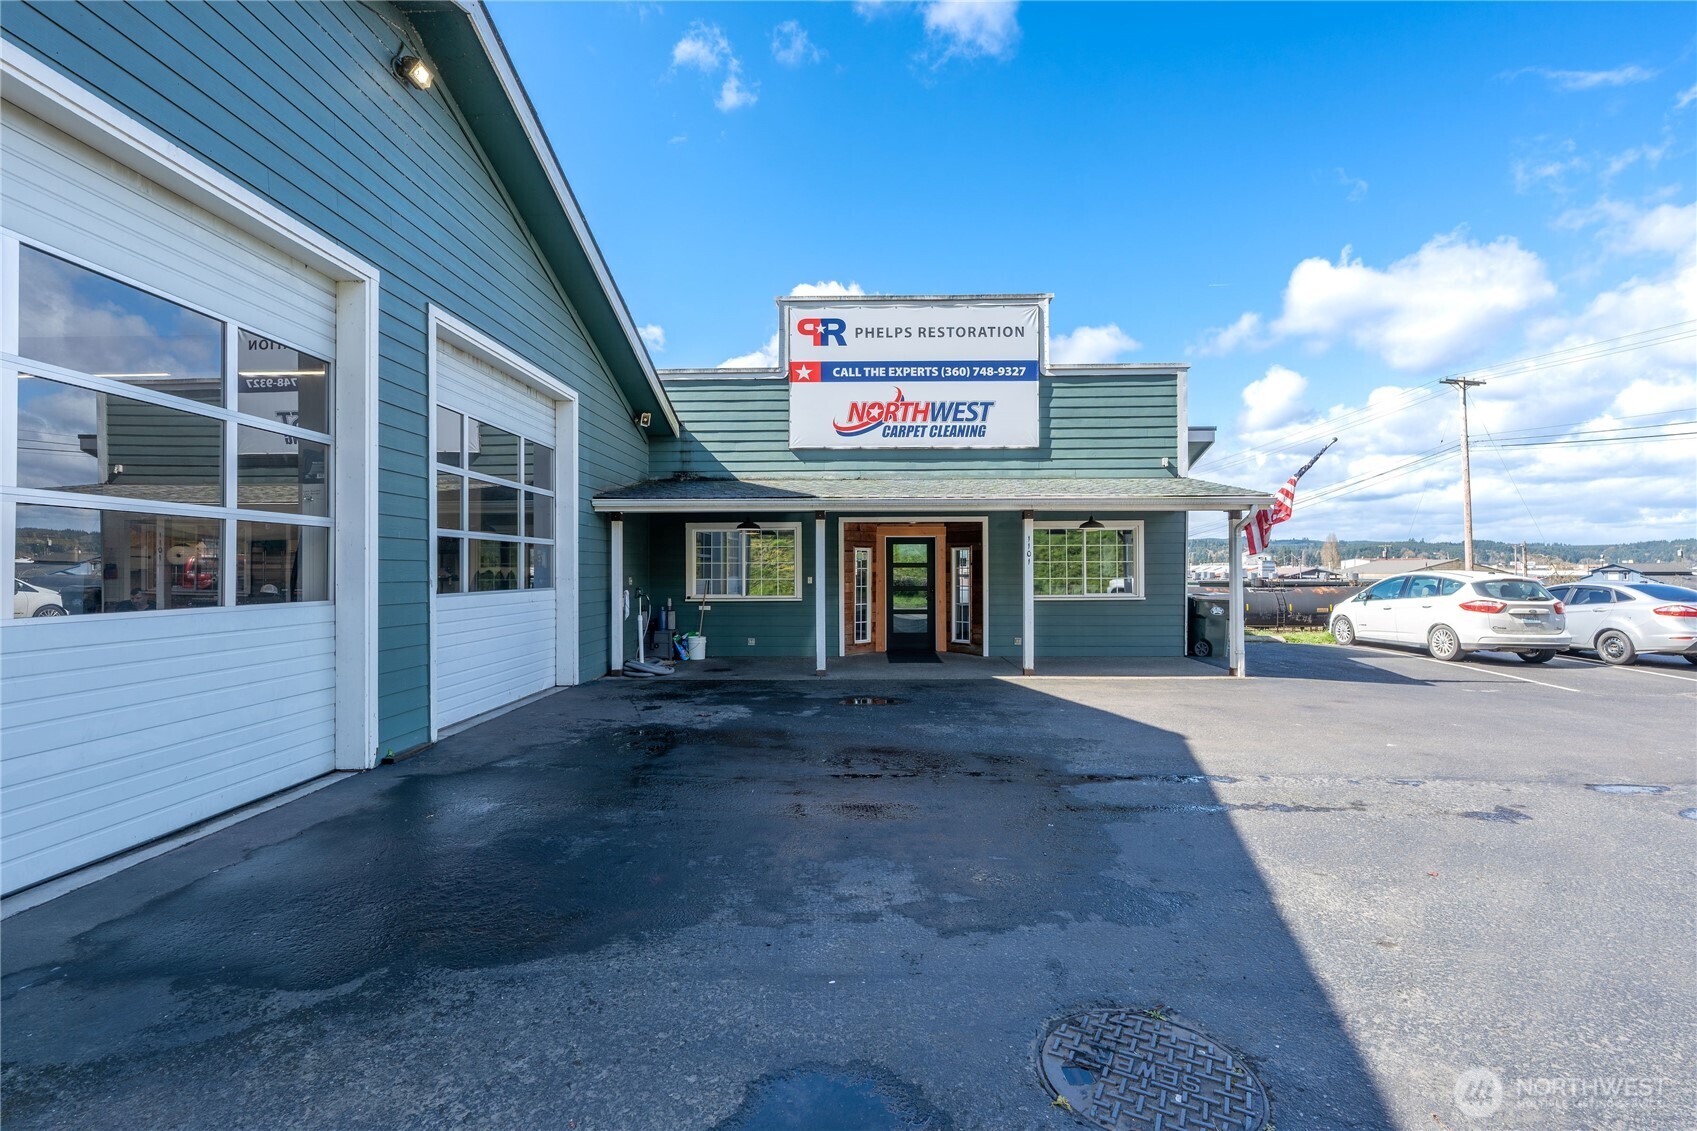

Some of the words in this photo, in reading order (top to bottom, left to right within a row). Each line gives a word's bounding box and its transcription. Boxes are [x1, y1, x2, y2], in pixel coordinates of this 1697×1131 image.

[855, 327, 912, 338] PHELPS
[918, 326, 1025, 338] RESTORATION
[833, 367, 861, 377] CALL
[863, 367, 886, 377] THE
[888, 367, 939, 377] EXPERTS
[941, 366, 970, 378] (360)
[972, 366, 1027, 377] 748-9327
[847, 401, 995, 422] NORTHWEST
[882, 424, 928, 437] CARPET
[931, 424, 986, 437] CLEANING
